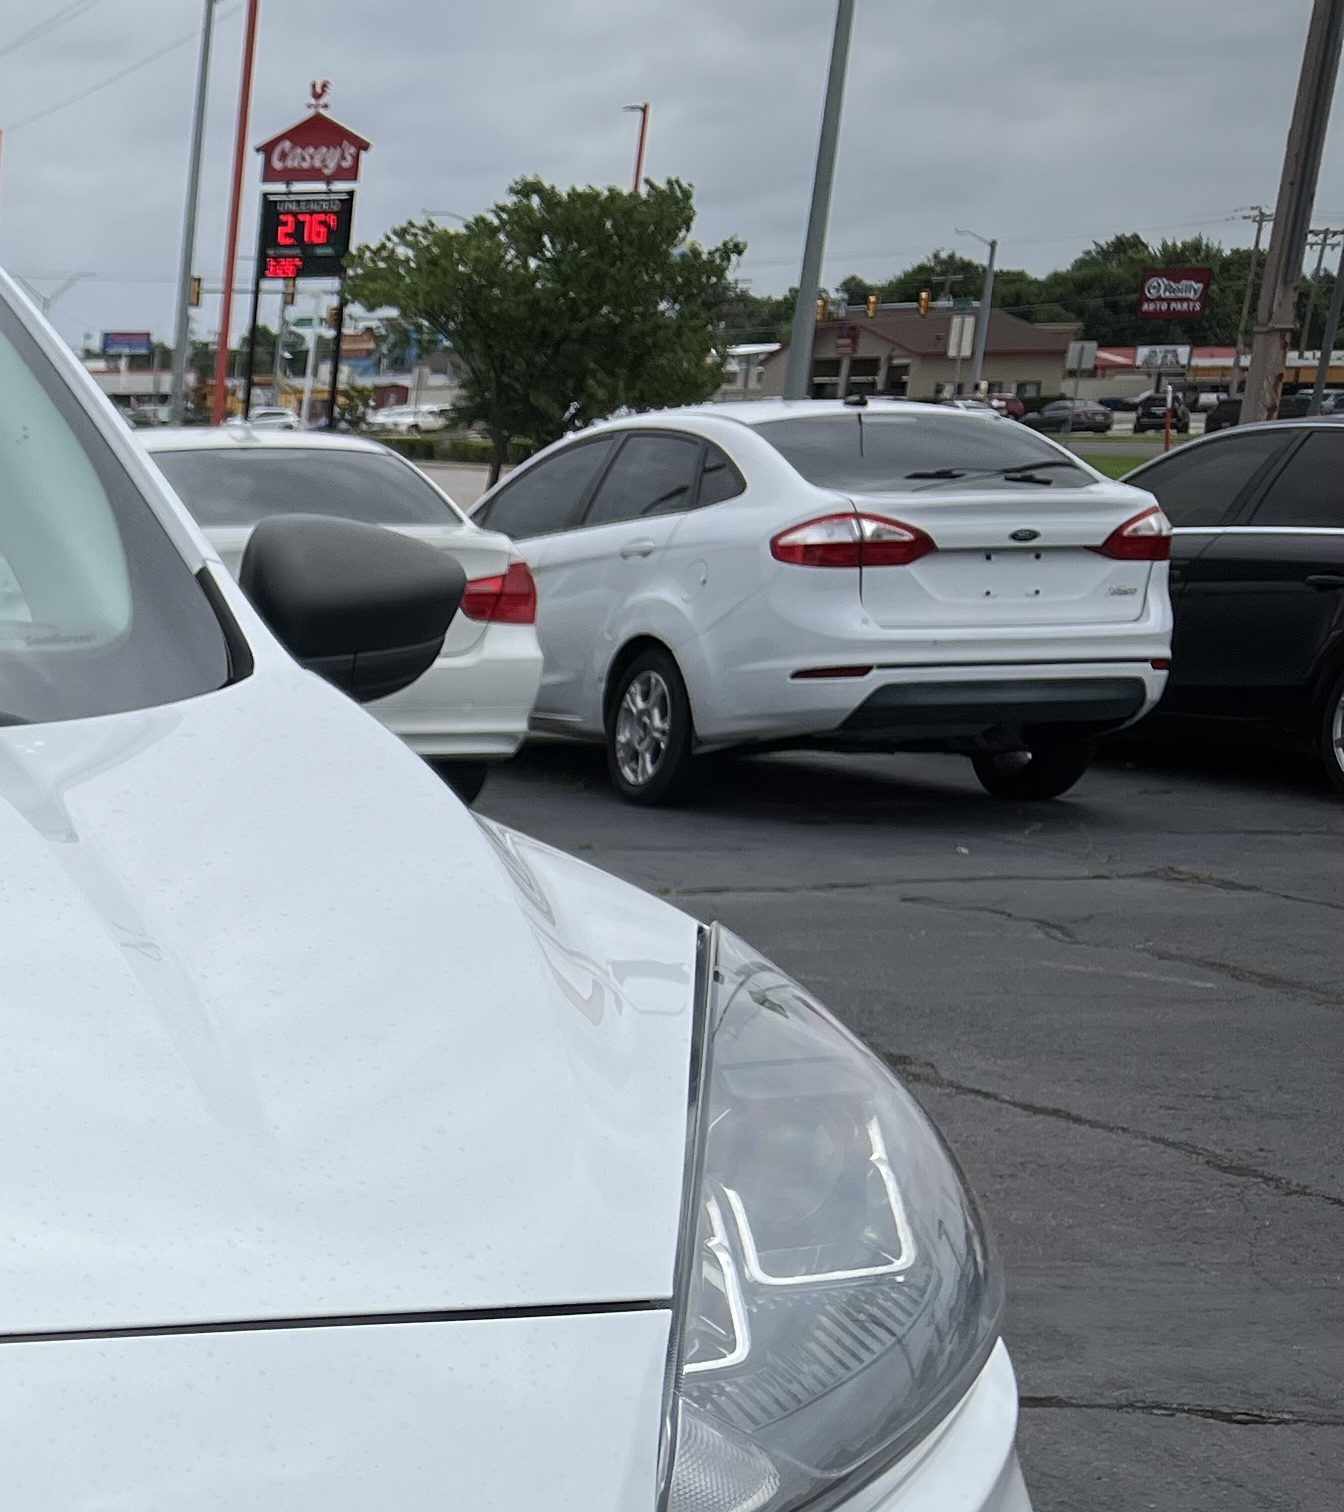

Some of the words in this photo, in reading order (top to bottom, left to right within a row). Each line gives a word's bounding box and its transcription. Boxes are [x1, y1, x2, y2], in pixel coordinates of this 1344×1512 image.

[271, 139, 357, 176] Casey's
[1145, 278, 1204, 300] O'Reilly
[1142, 302, 1168, 311] AUTO
[1170, 302, 1201, 311] PARTS
